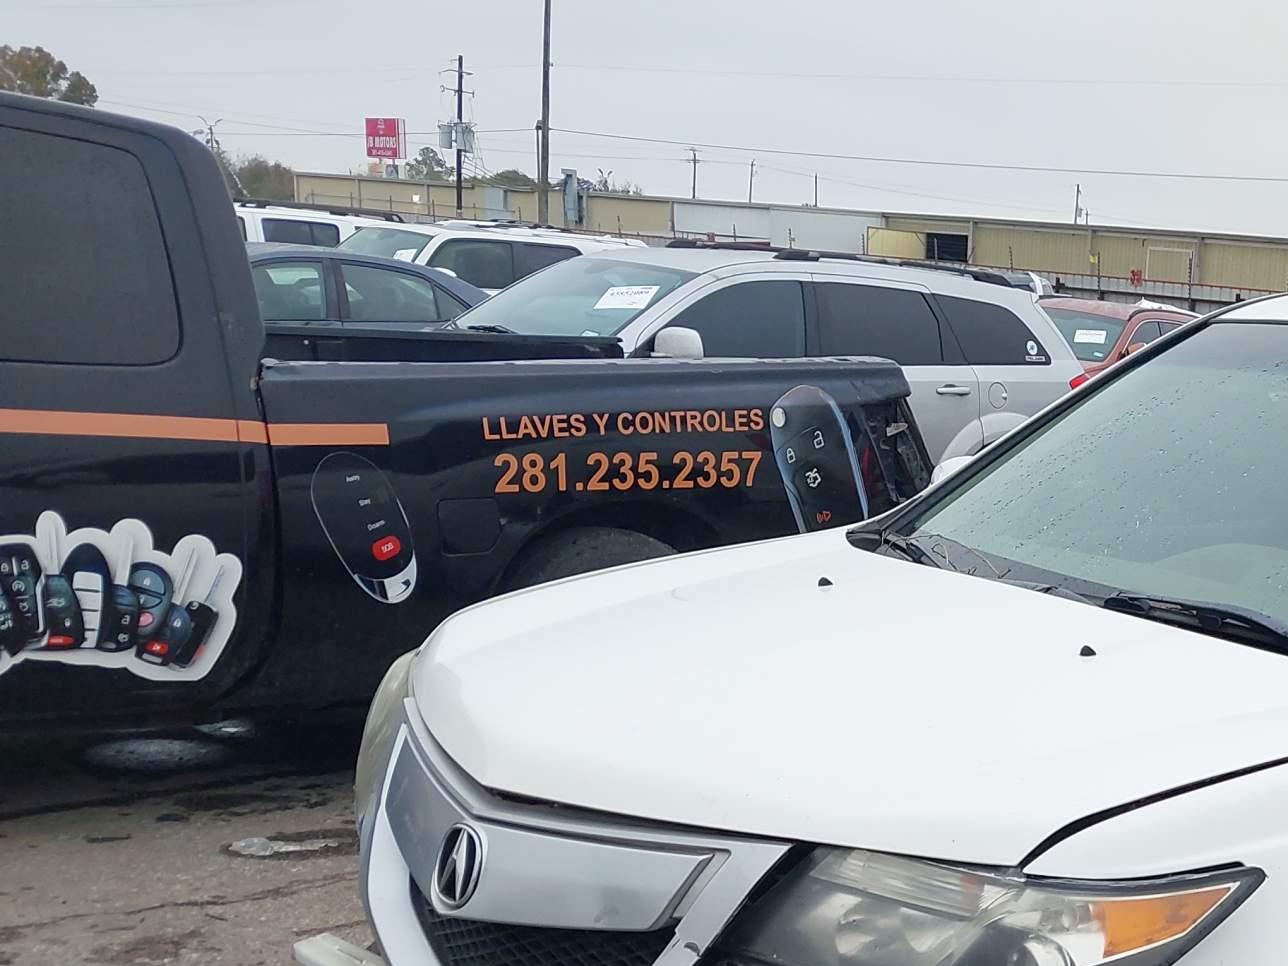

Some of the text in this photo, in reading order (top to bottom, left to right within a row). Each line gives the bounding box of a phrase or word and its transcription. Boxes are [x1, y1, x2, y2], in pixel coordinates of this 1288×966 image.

[375, 136, 396, 148] MOTORS
[482, 408, 764, 440] LLAVES Y CONTROLES
[494, 451, 762, 493] 281.235.2357
